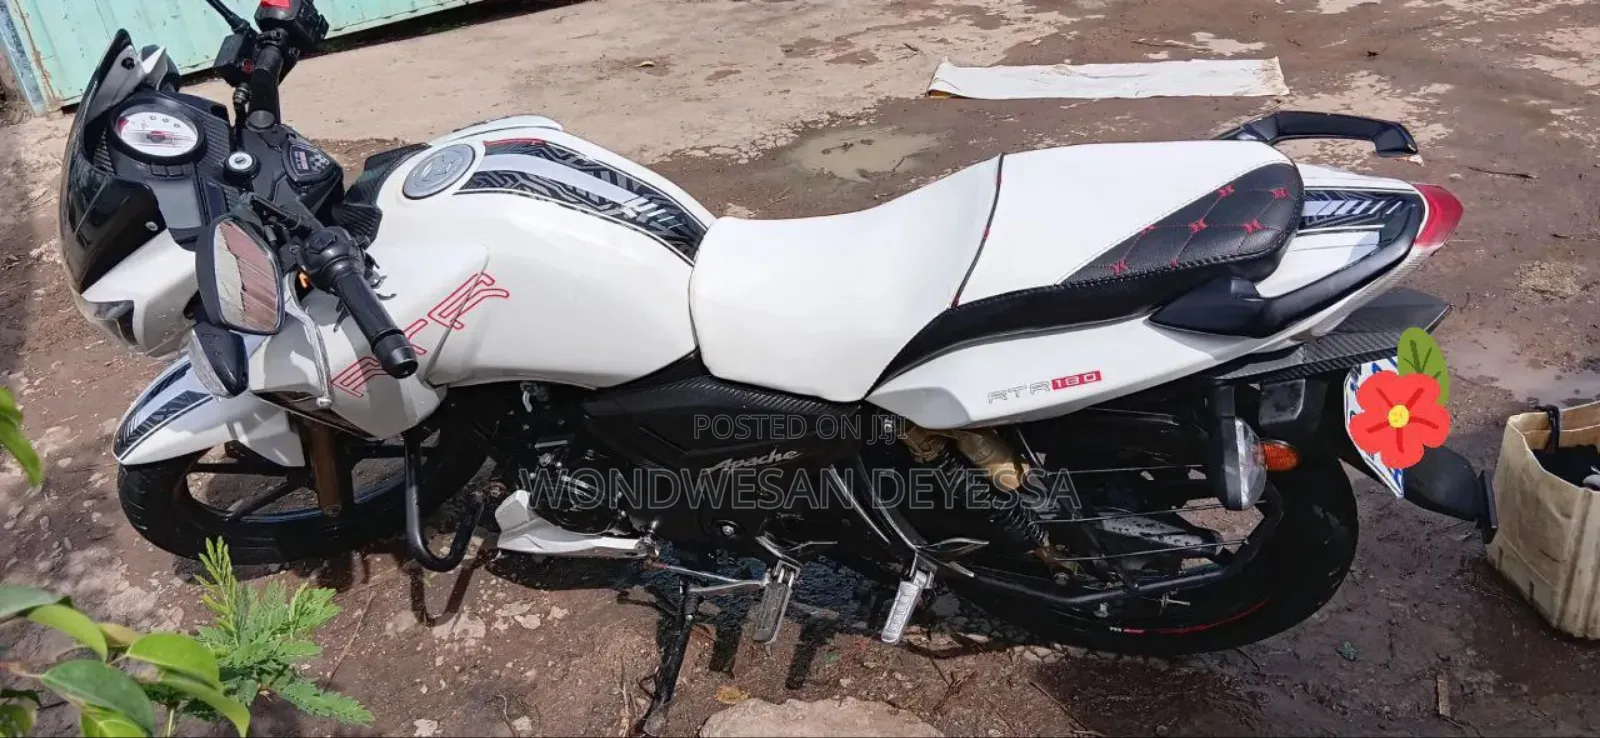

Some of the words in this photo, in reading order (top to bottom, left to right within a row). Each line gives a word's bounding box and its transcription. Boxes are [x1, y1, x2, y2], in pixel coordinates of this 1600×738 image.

[987, 380, 1051, 404] RTR
[1053, 372, 1099, 389] 180
[702, 449, 802, 475] Apache
